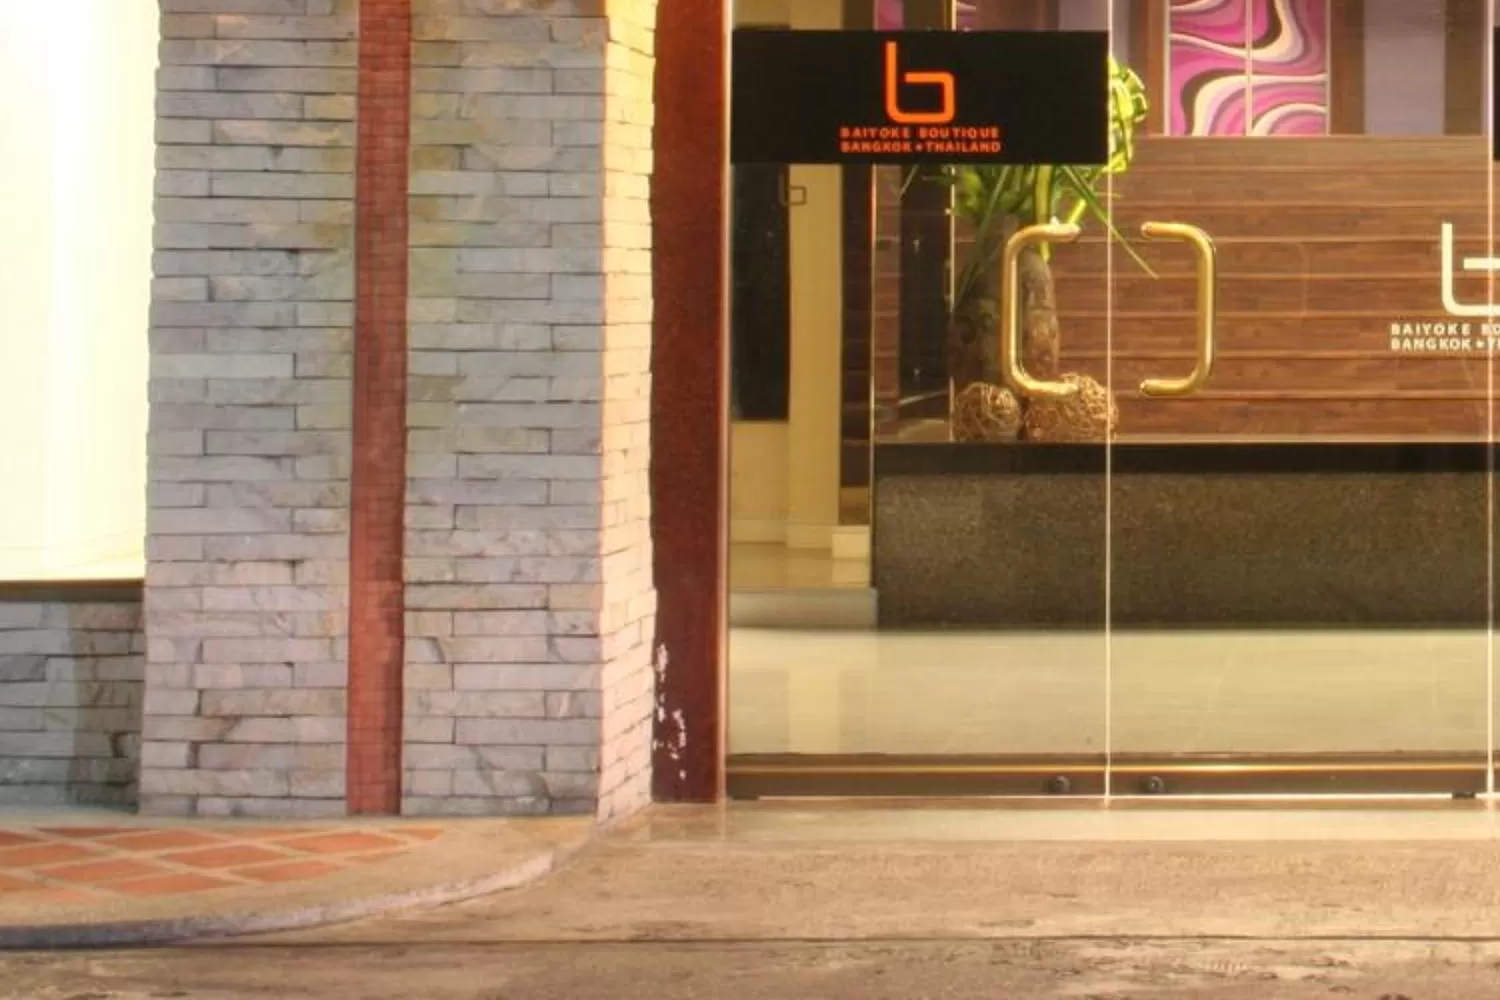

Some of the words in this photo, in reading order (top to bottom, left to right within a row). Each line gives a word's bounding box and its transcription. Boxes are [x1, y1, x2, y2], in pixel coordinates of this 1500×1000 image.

[839, 127, 911, 139] BAIYOKE
[919, 127, 1000, 139] BOUTIQUE
[839, 140, 912, 153] BANGKOK
[925, 140, 1001, 153] THAILAND
[1390, 323, 1472, 336] BAIYOKE
[1390, 337, 1472, 351] BANGKOK
